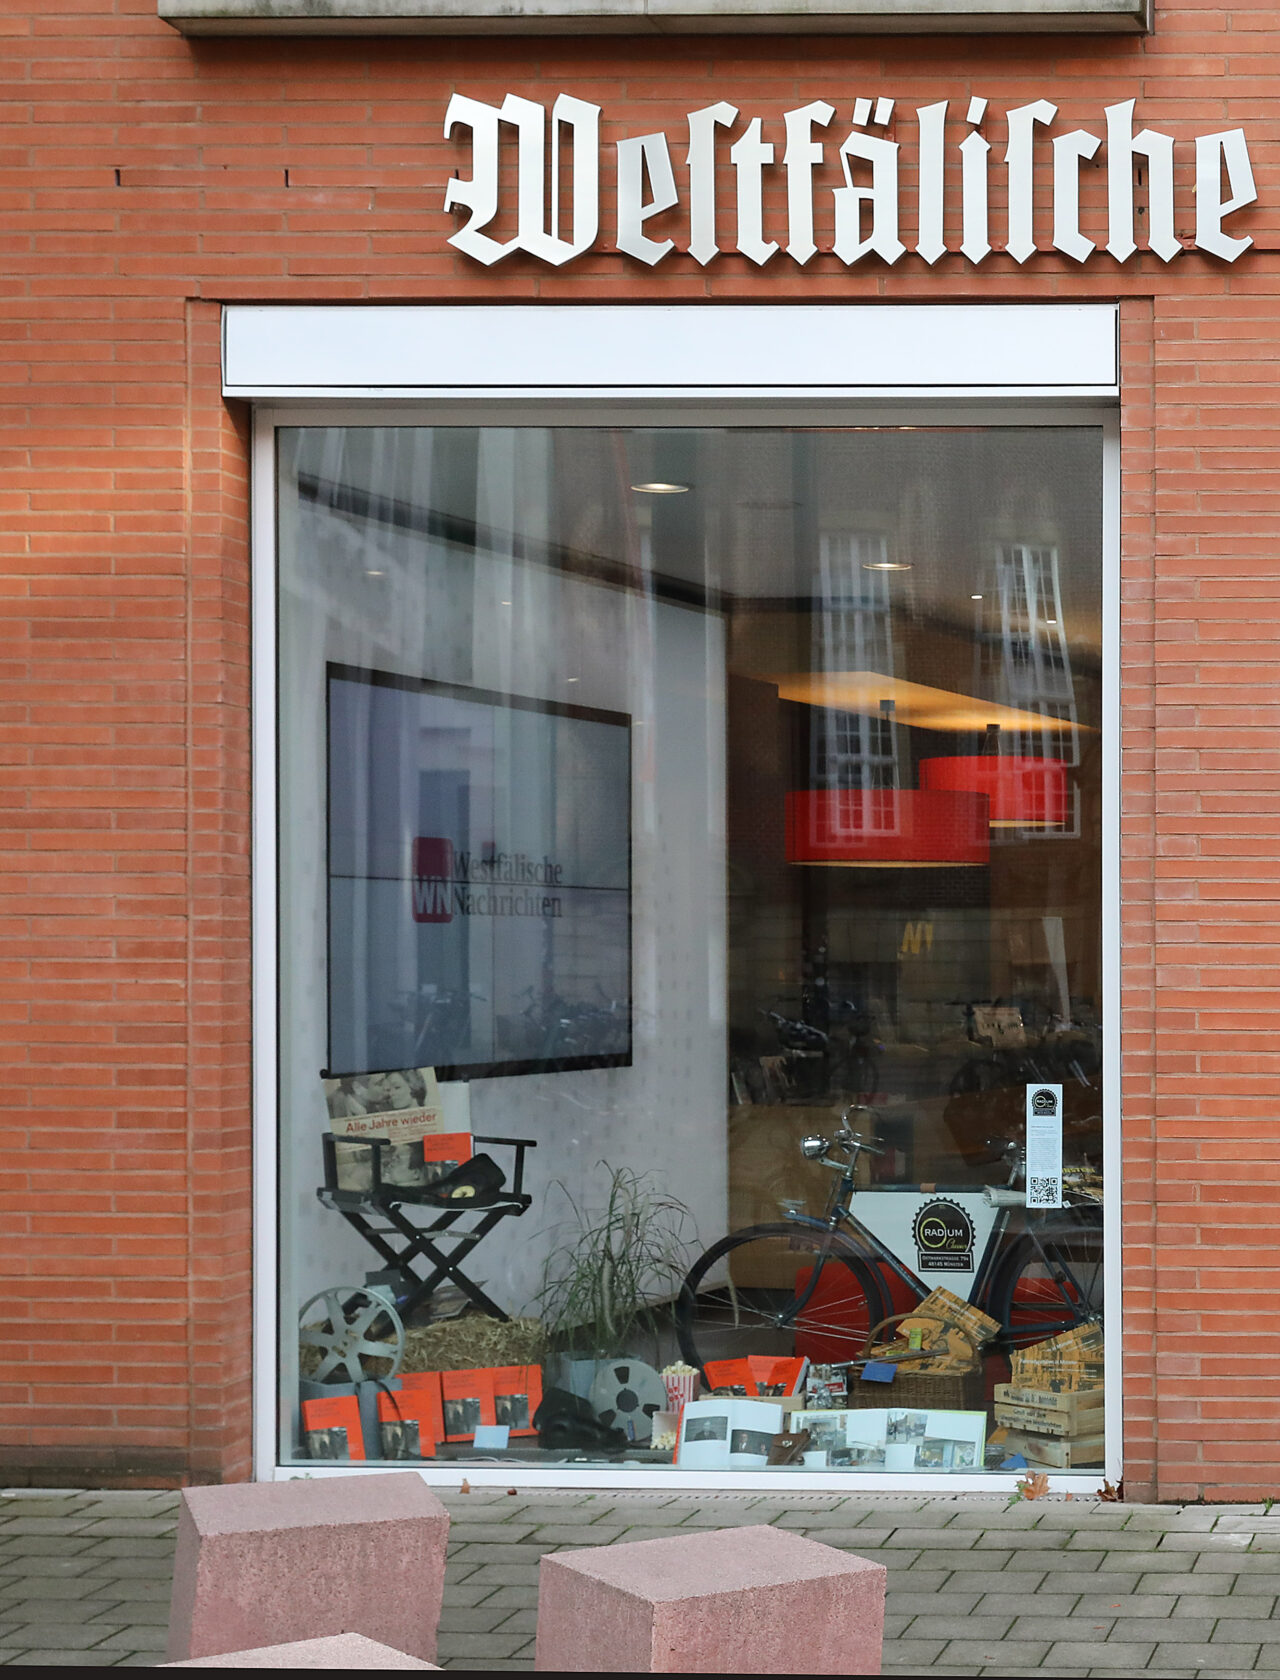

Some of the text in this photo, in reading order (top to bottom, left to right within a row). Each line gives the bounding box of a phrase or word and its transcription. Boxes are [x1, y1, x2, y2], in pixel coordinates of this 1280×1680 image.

[454, 851, 563, 884] Westfälische
[454, 886, 563, 917] Nachrichten
[346, 1112, 436, 1133] Alle Jahre wieder
[924, 1228, 963, 1237] RADIUM
